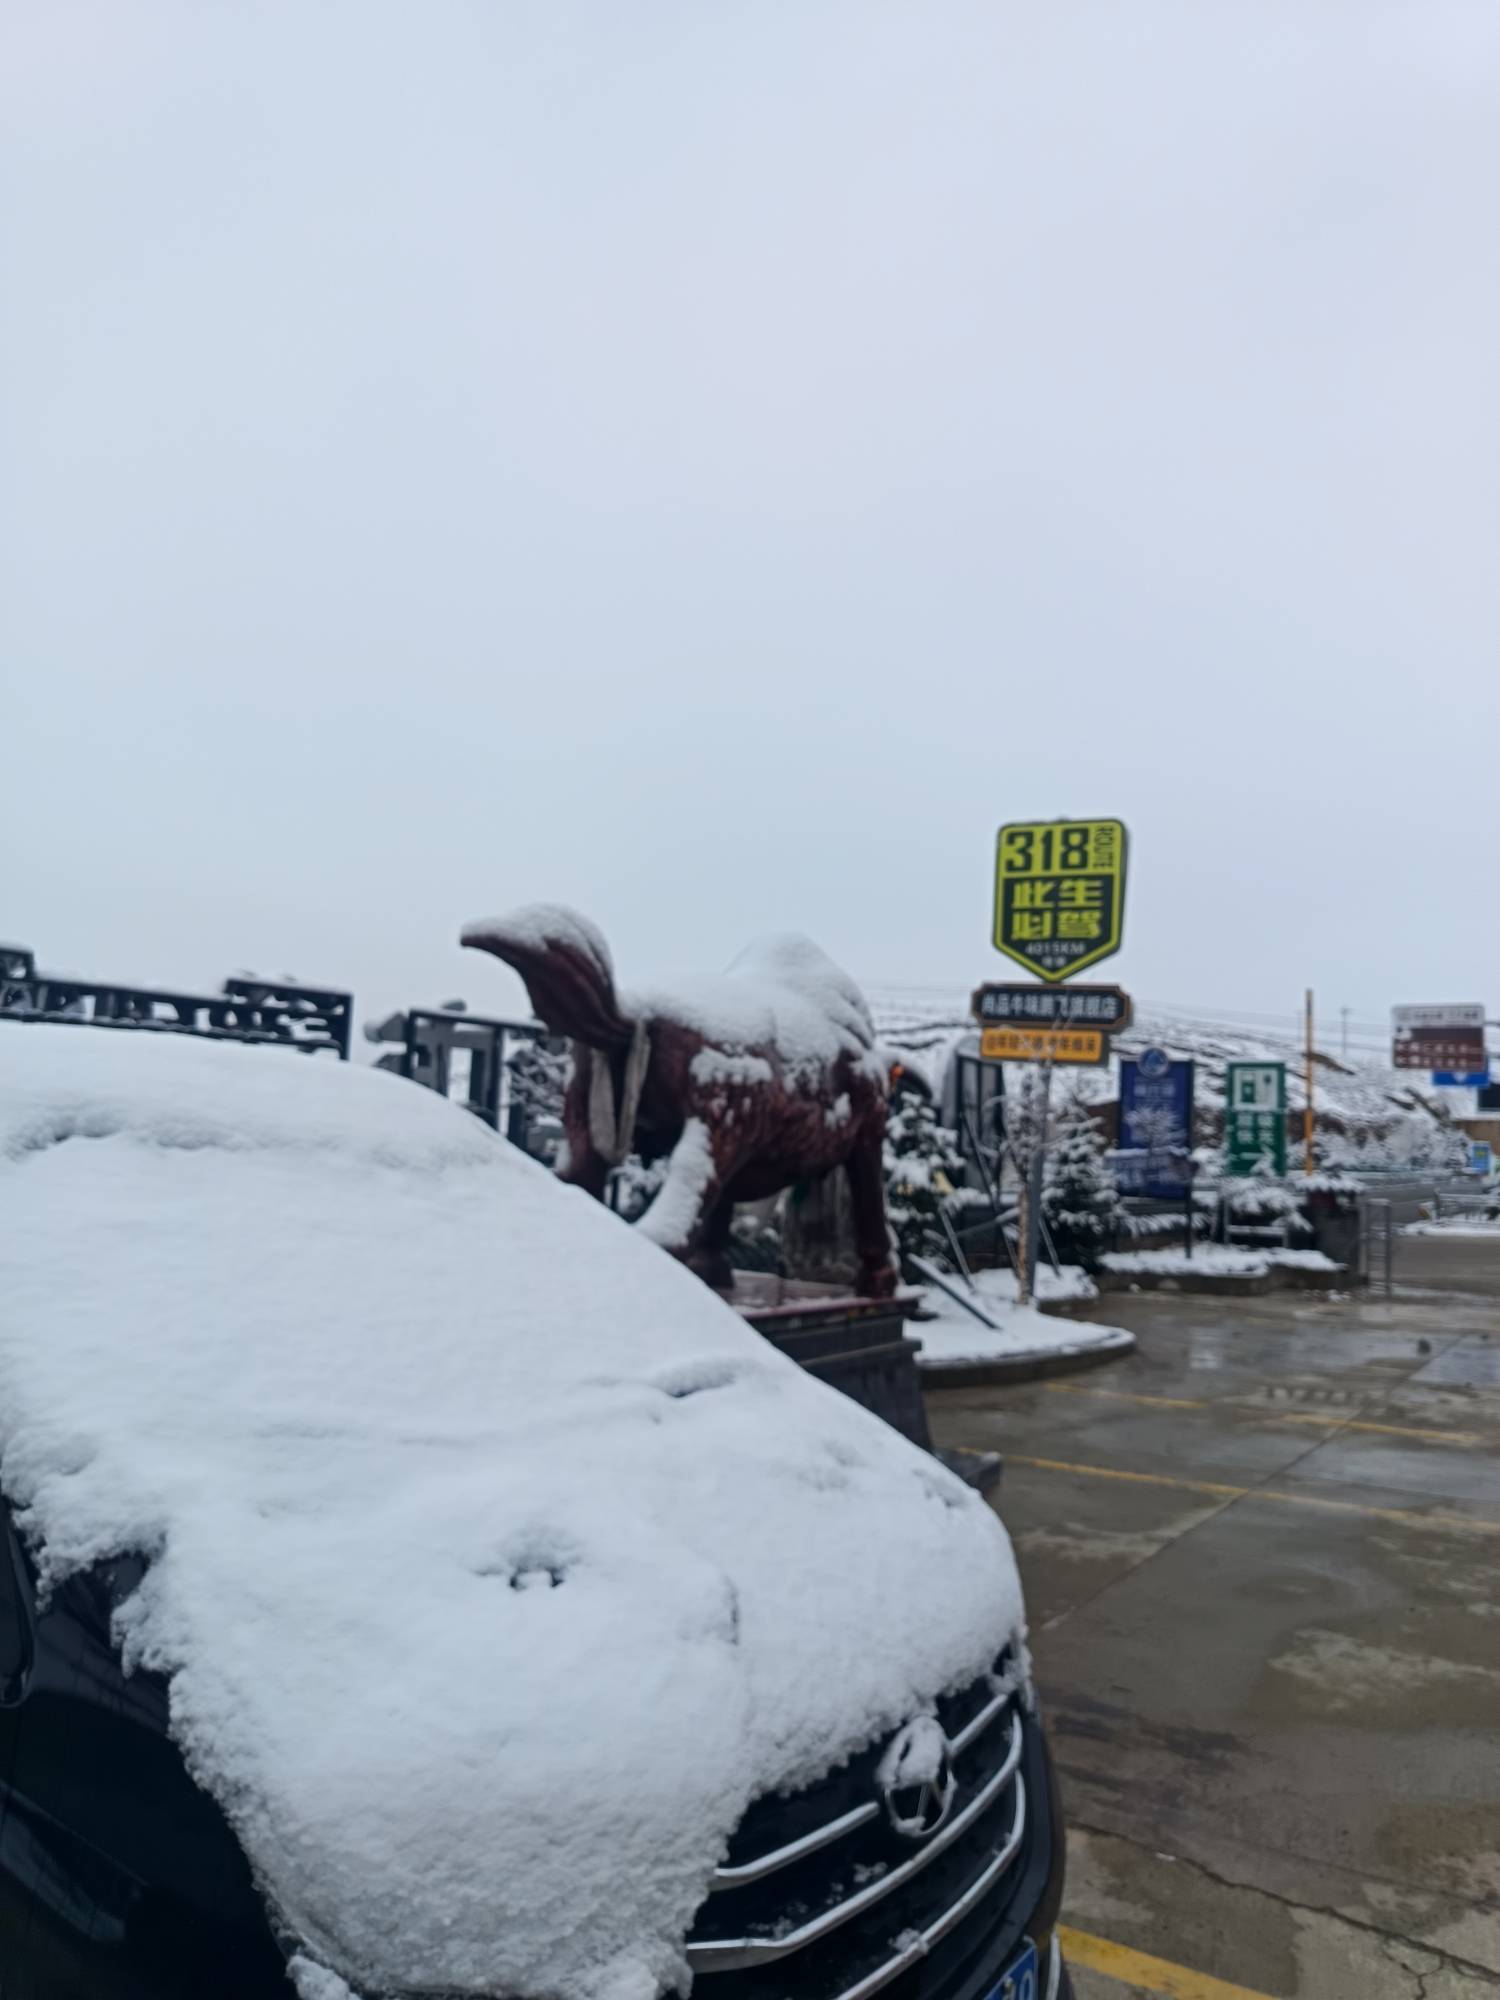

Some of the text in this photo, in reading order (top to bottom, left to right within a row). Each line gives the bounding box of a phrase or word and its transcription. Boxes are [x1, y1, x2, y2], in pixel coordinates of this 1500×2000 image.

[1005, 828, 1090, 873] 318
[1012, 879, 1102, 909] 此生
[1011, 910, 1102, 940] 必驾
